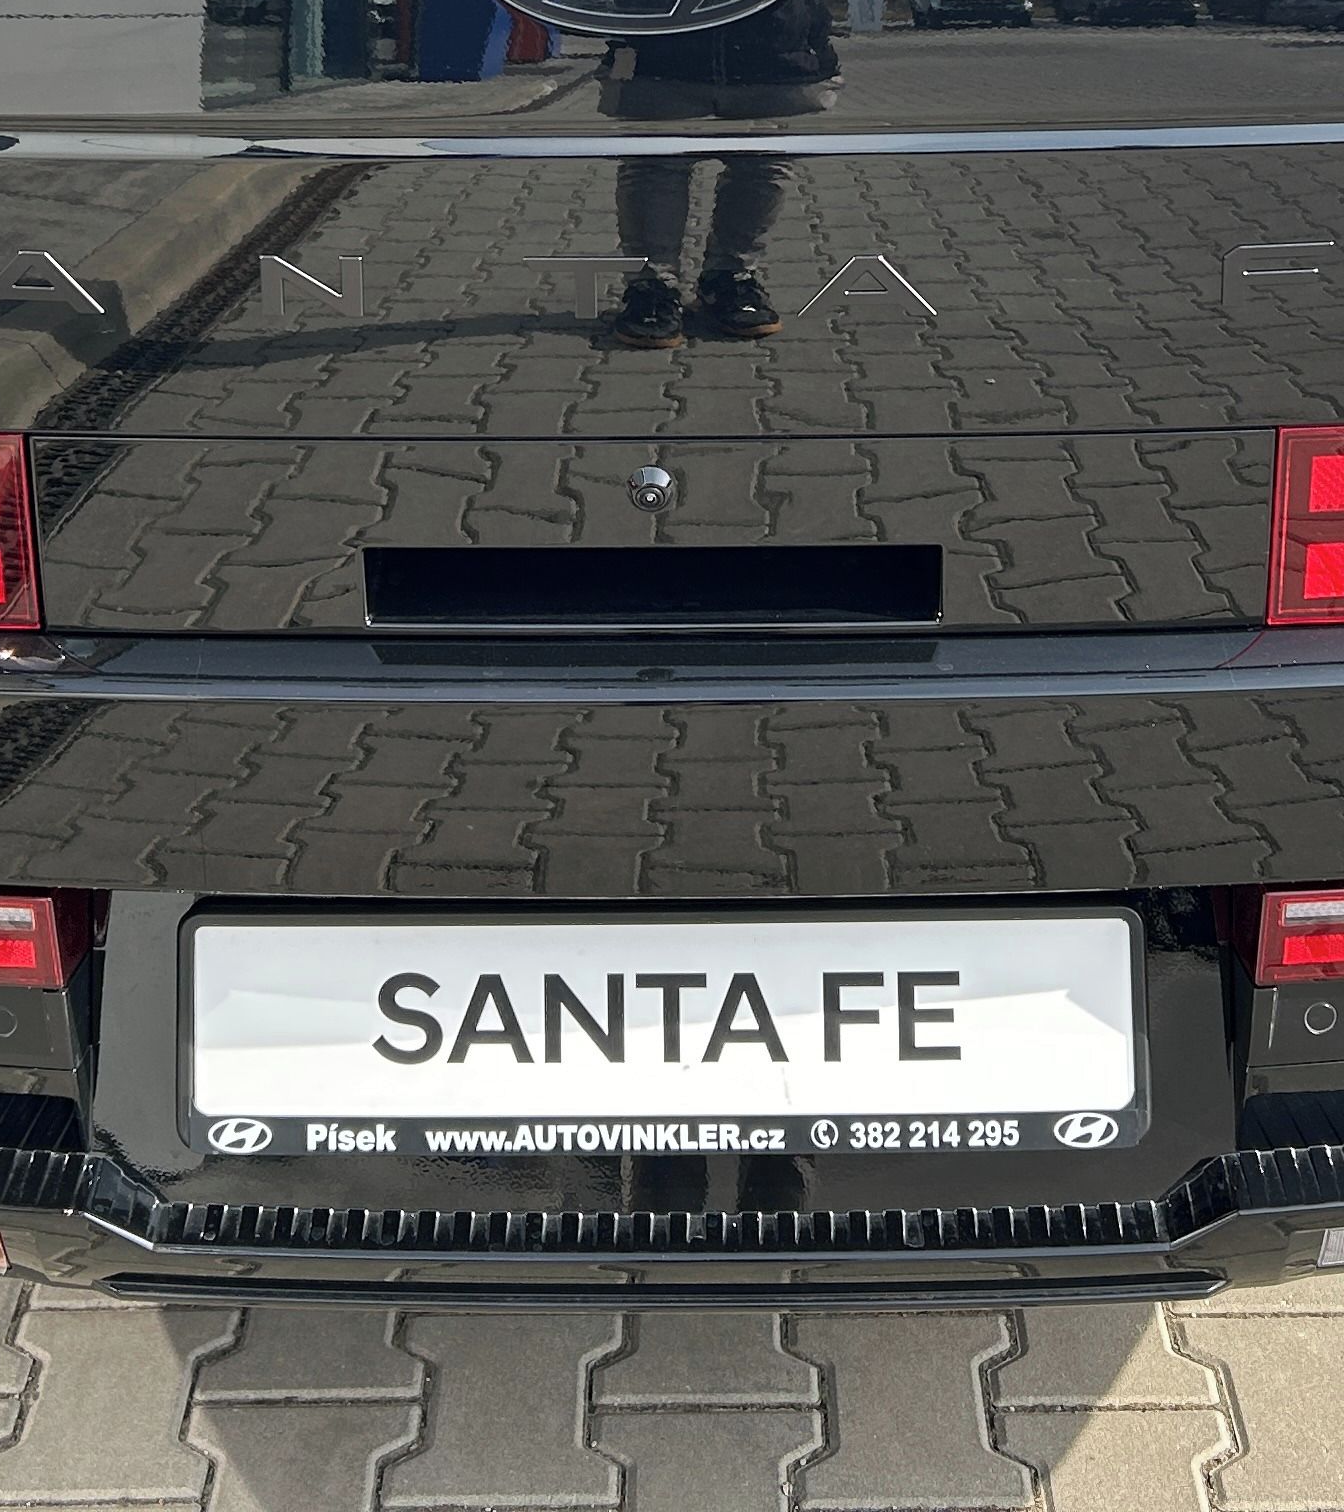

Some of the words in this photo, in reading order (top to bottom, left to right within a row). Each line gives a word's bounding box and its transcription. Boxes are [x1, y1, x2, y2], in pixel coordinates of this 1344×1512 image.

[372, 971, 790, 1064] SANTA
[821, 971, 962, 1062] FE
[306, 1124, 397, 1152] Písek
[425, 1123, 786, 1152] www.AUTOVINKLER.cz
[849, 1121, 901, 1149] 382
[908, 1120, 961, 1148] 214
[967, 1119, 1020, 1147] 295
